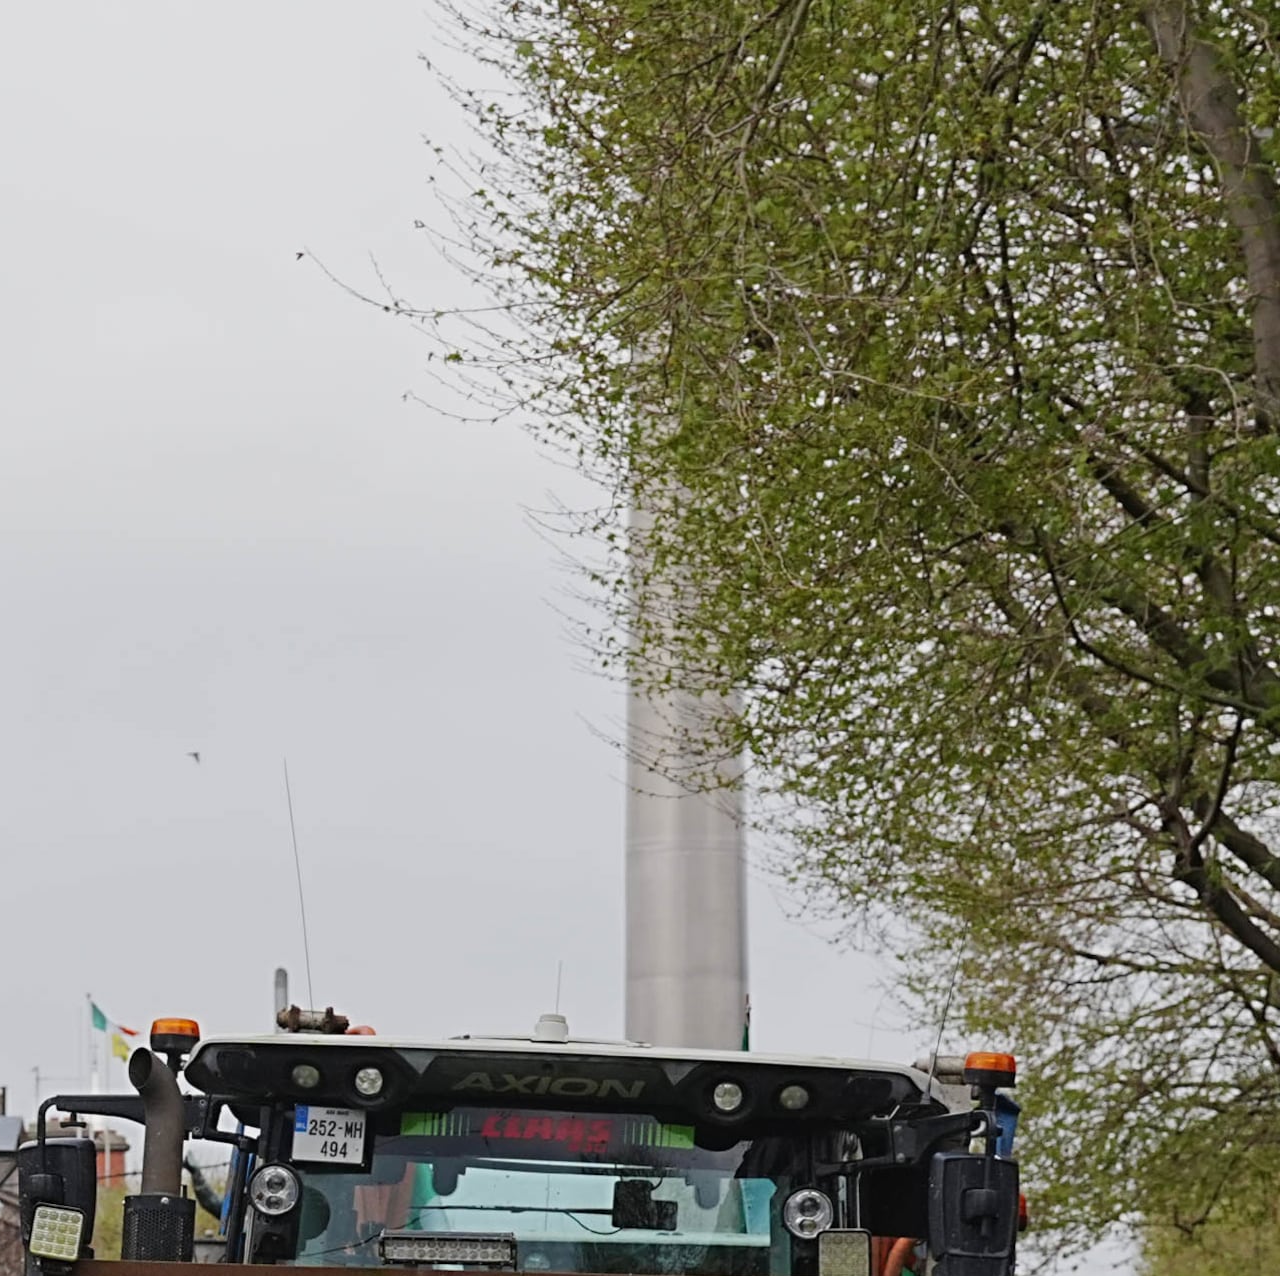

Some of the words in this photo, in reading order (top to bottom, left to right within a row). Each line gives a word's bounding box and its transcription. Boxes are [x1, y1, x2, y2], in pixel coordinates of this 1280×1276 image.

[451, 1072, 646, 1098] AXION
[308, 1119, 364, 1139] 252-MH
[481, 1113, 614, 1144] CLAAS
[320, 1141, 348, 1159] 494
